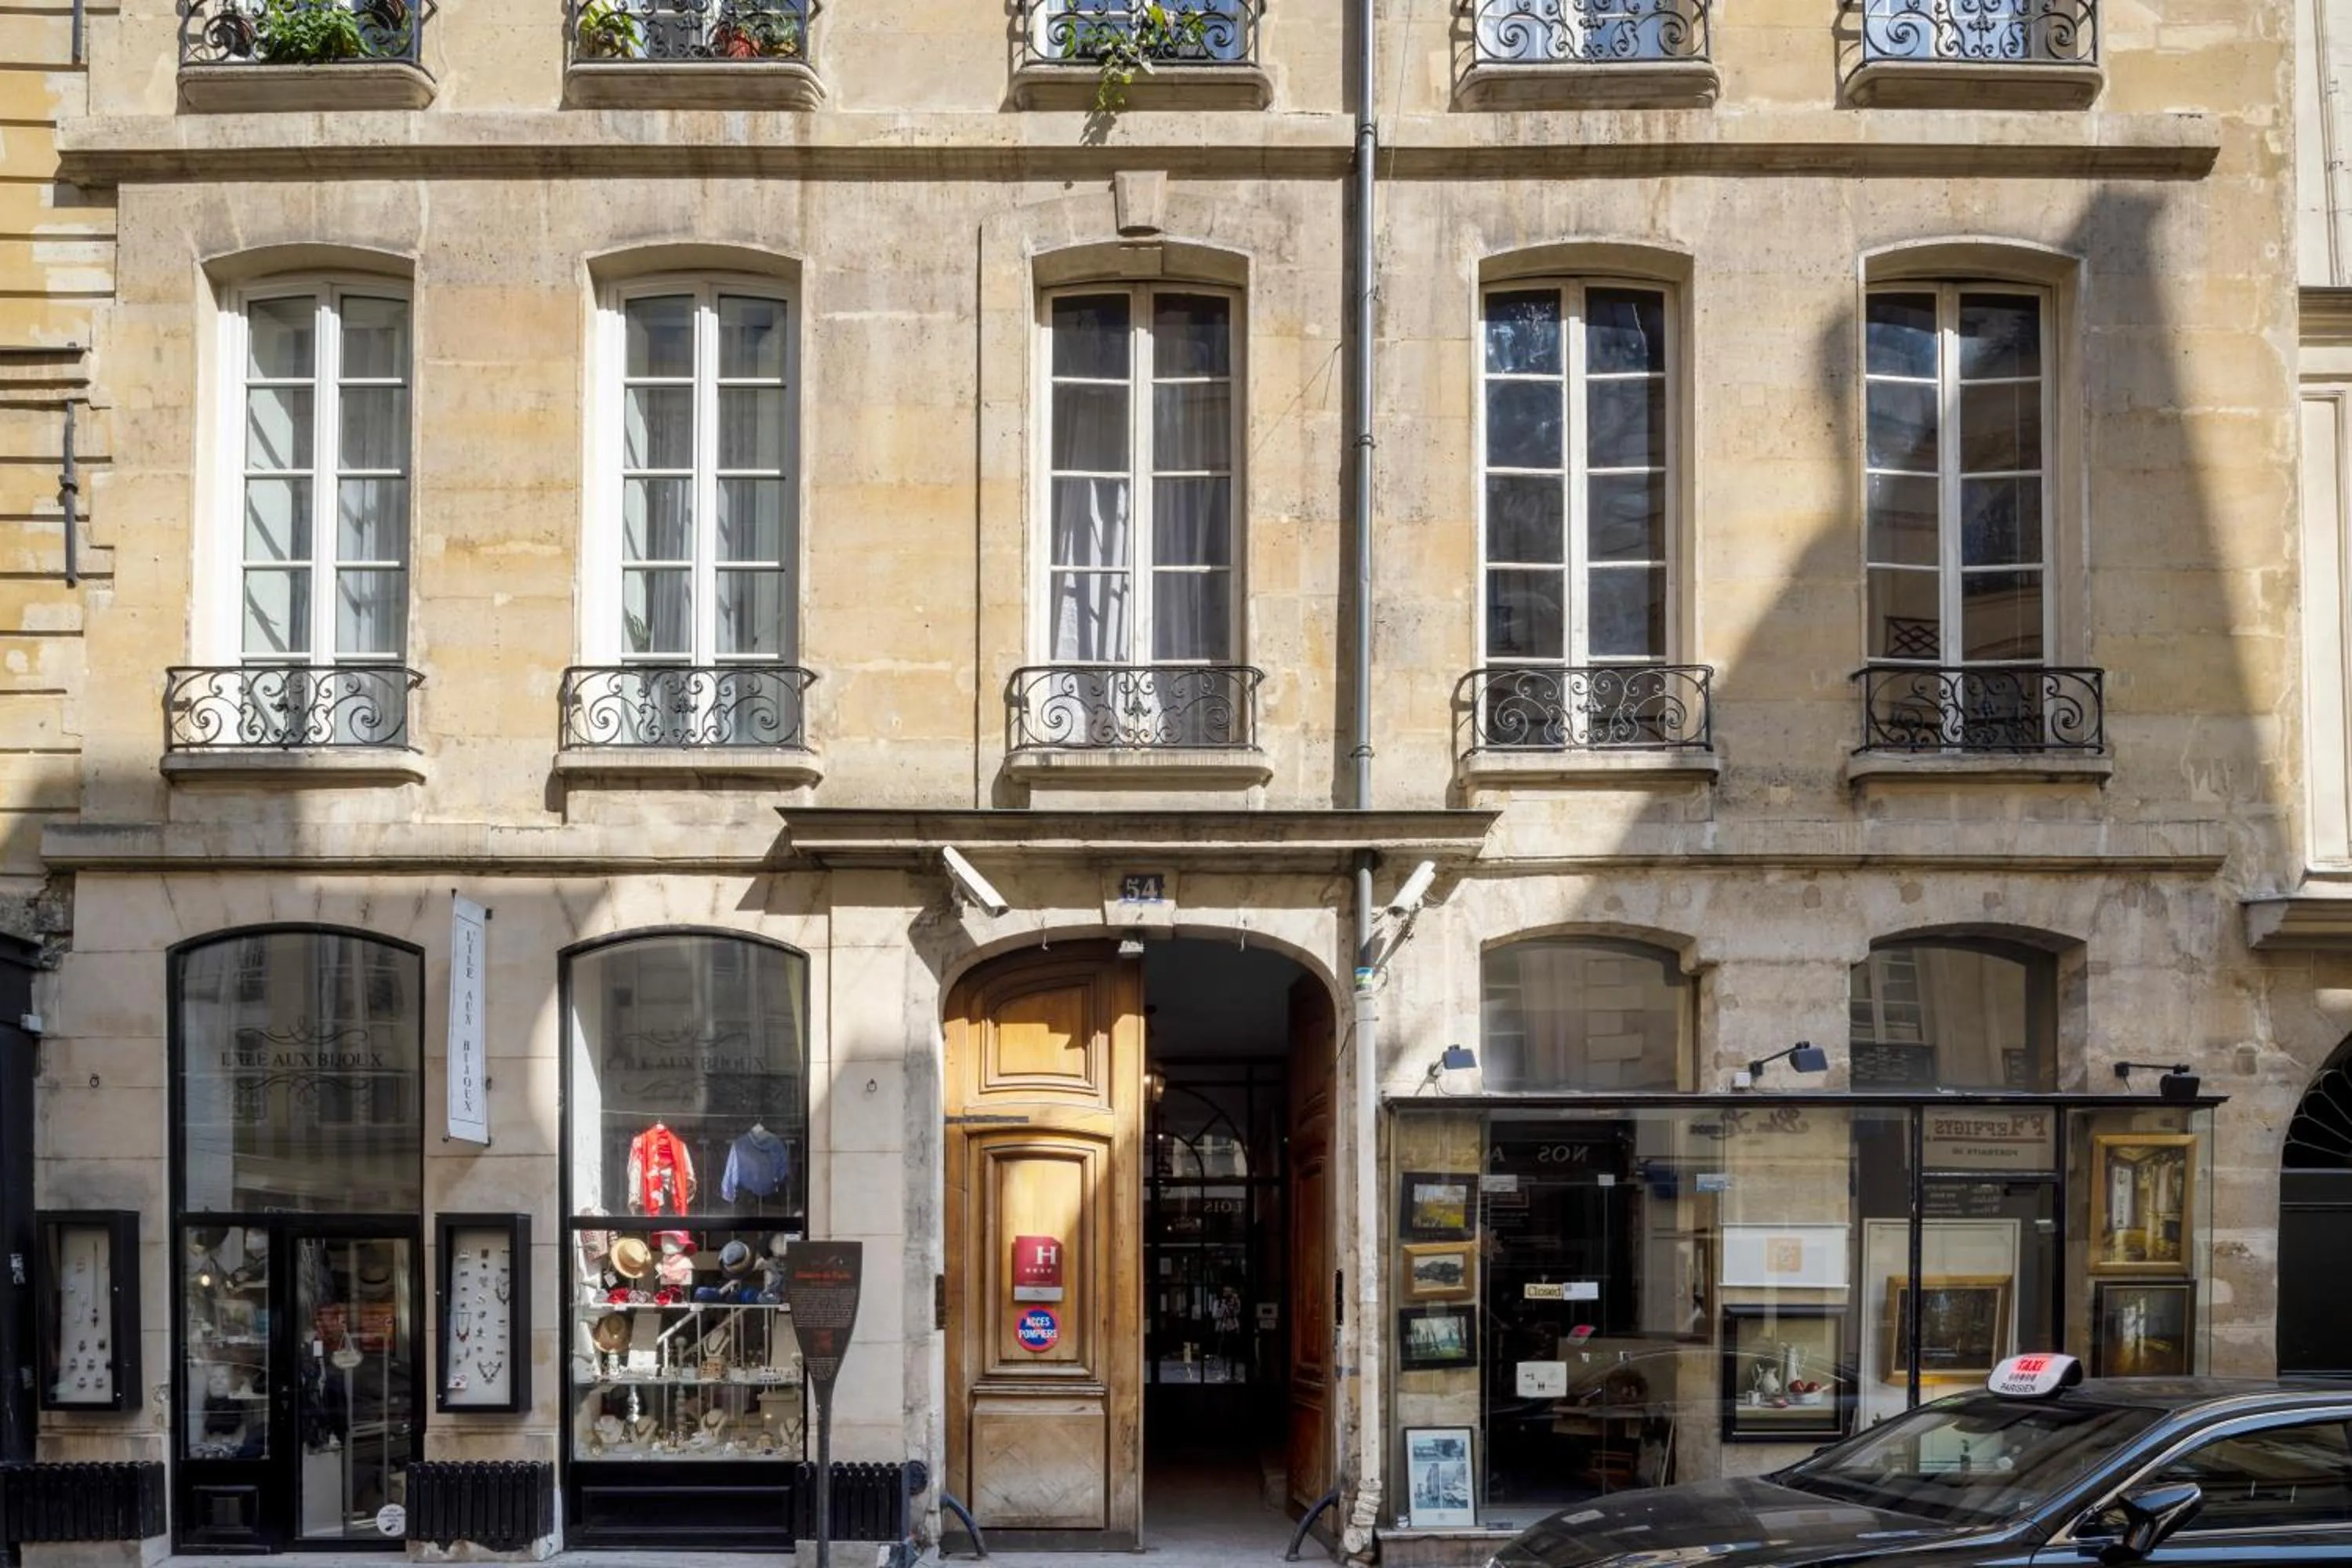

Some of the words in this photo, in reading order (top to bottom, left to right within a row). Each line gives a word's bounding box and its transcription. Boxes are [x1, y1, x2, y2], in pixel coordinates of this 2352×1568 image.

[1127, 877, 1159, 900] 54
[272, 1053, 311, 1067] AUX
[318, 1053, 383, 1067] BIJOUX
[1036, 1246, 1056, 1265] H
[1527, 1285, 1561, 1297] Closed
[1018, 1329, 1058, 1339] POMPIERS
[2017, 1359, 2045, 1371] TAXI
[2000, 1382, 2036, 1393] PARISIEN
